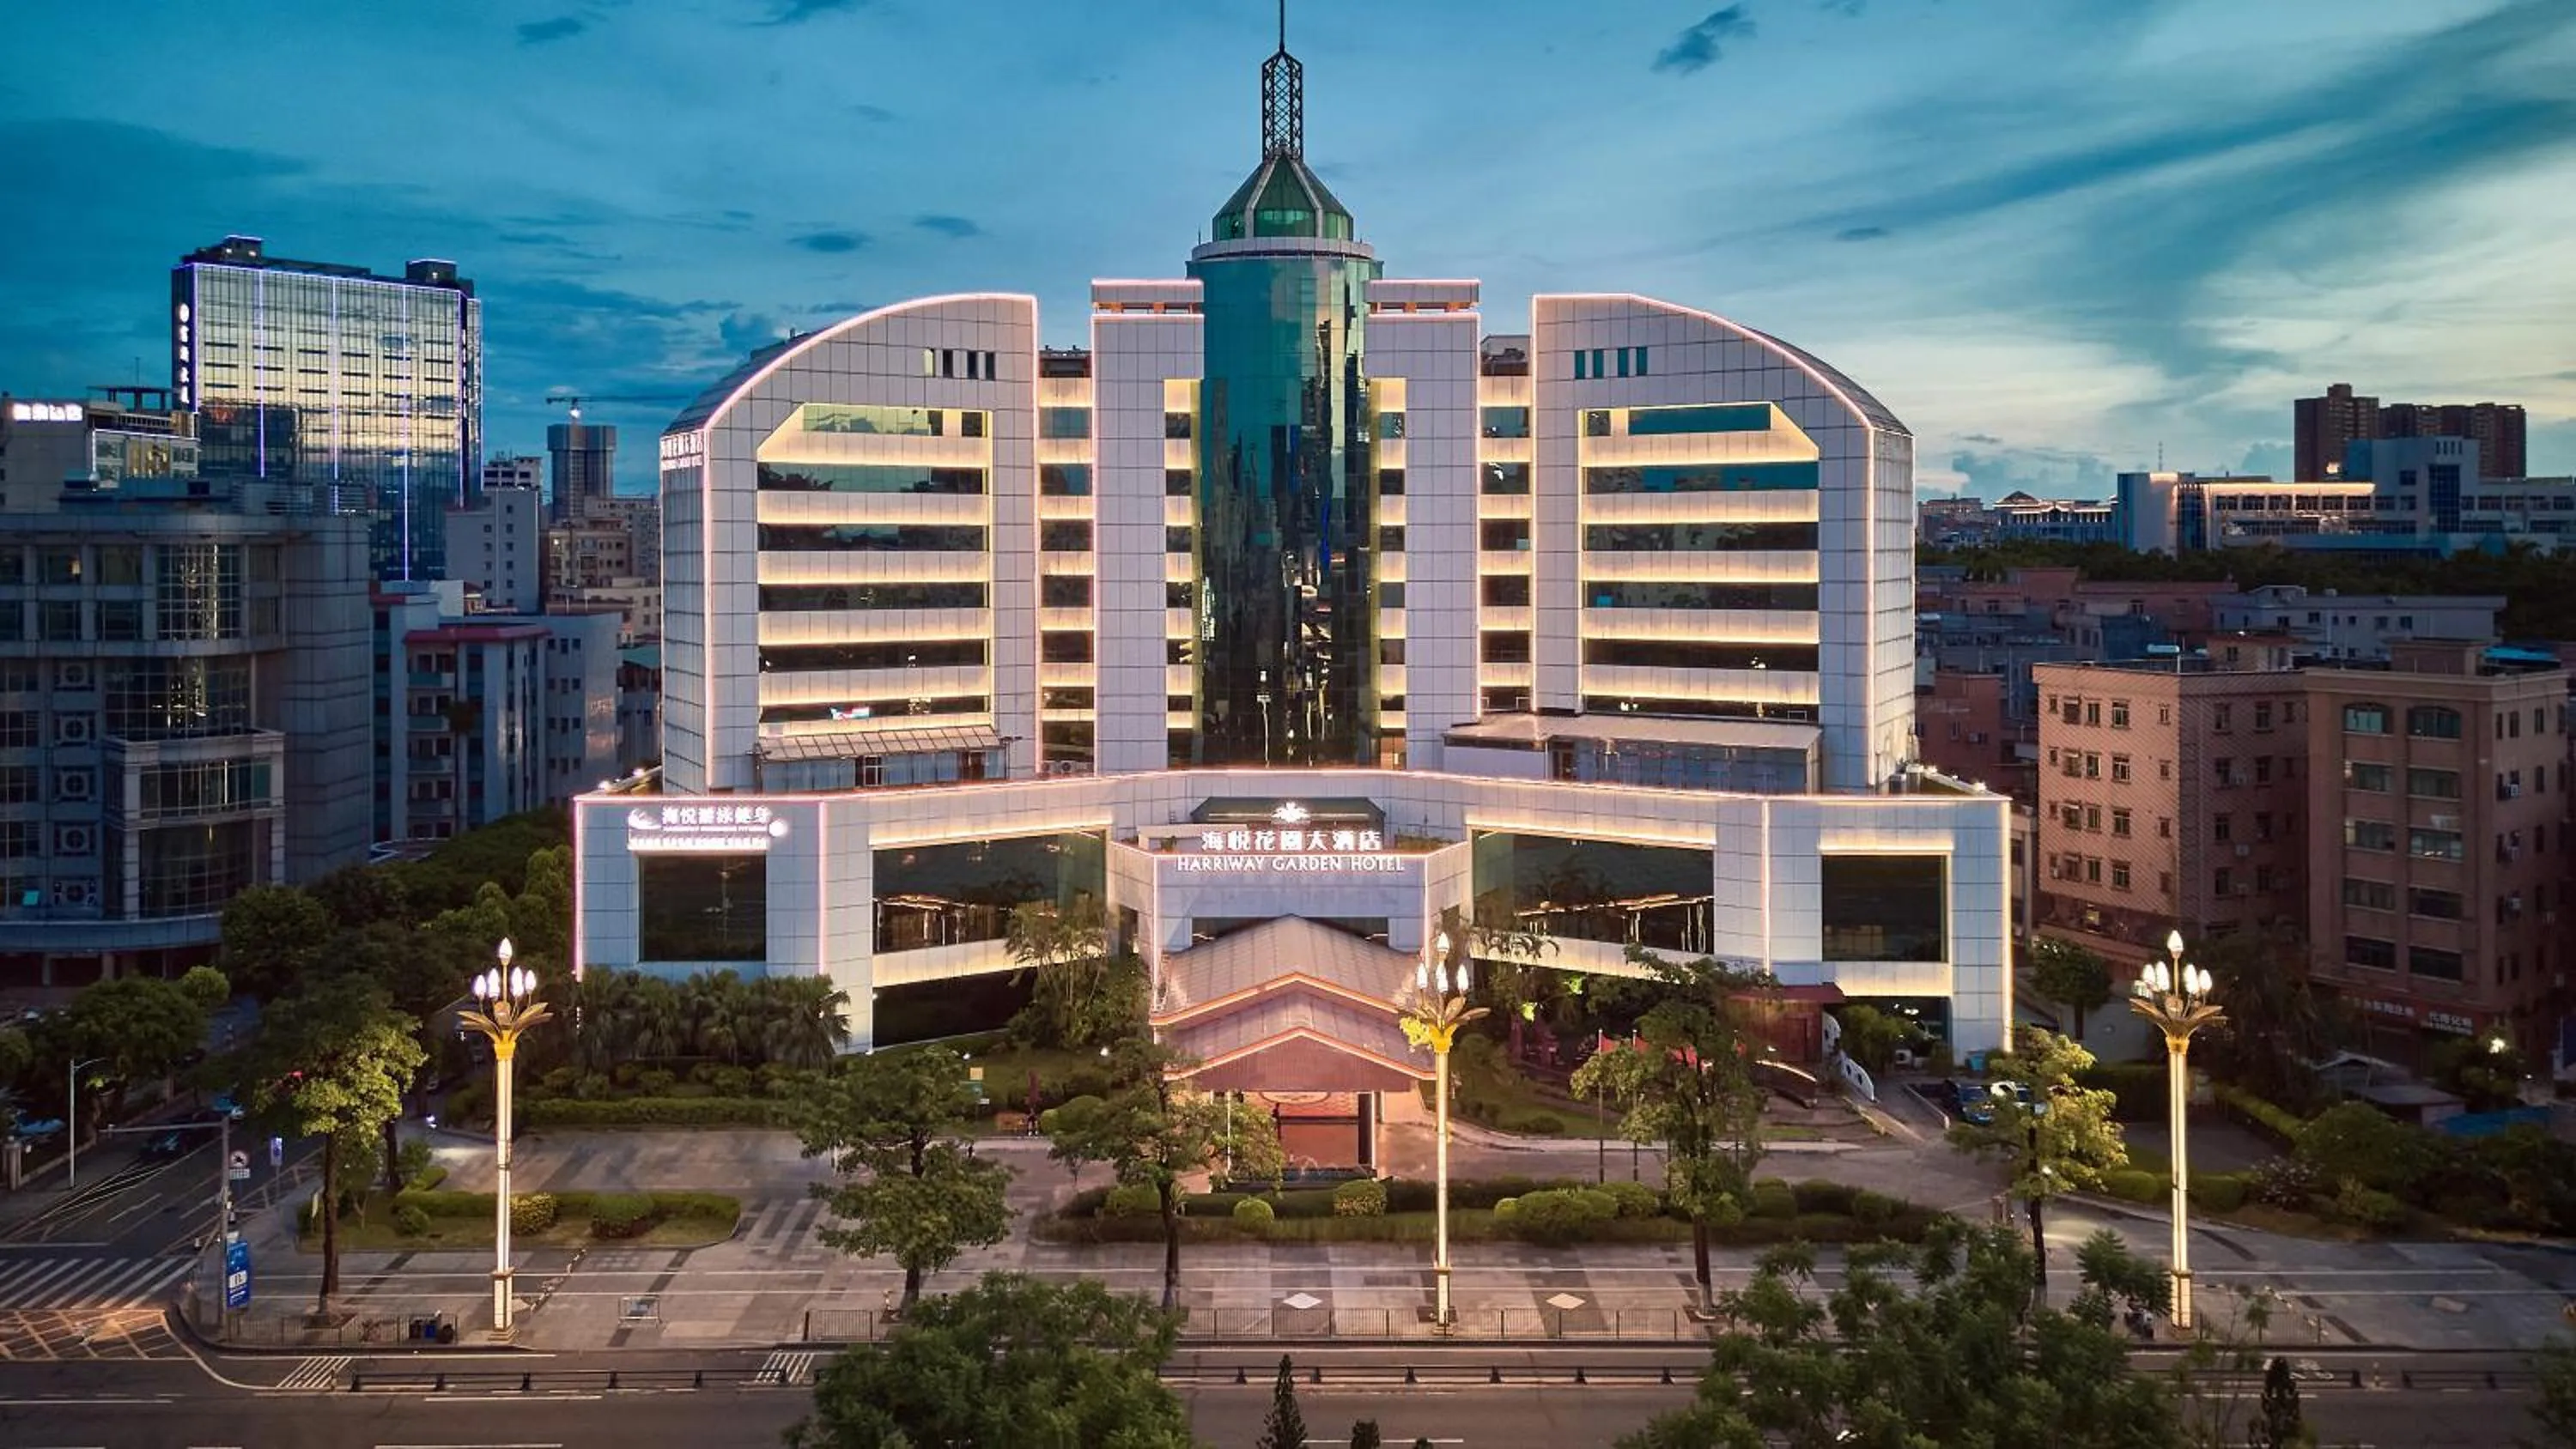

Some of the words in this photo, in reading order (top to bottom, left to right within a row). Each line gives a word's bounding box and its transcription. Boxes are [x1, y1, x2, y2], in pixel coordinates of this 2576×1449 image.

[1177, 857, 1264, 871] HARRIWAY
[1272, 857, 1341, 871] GARDEN
[1351, 857, 1404, 871] HOTEL
